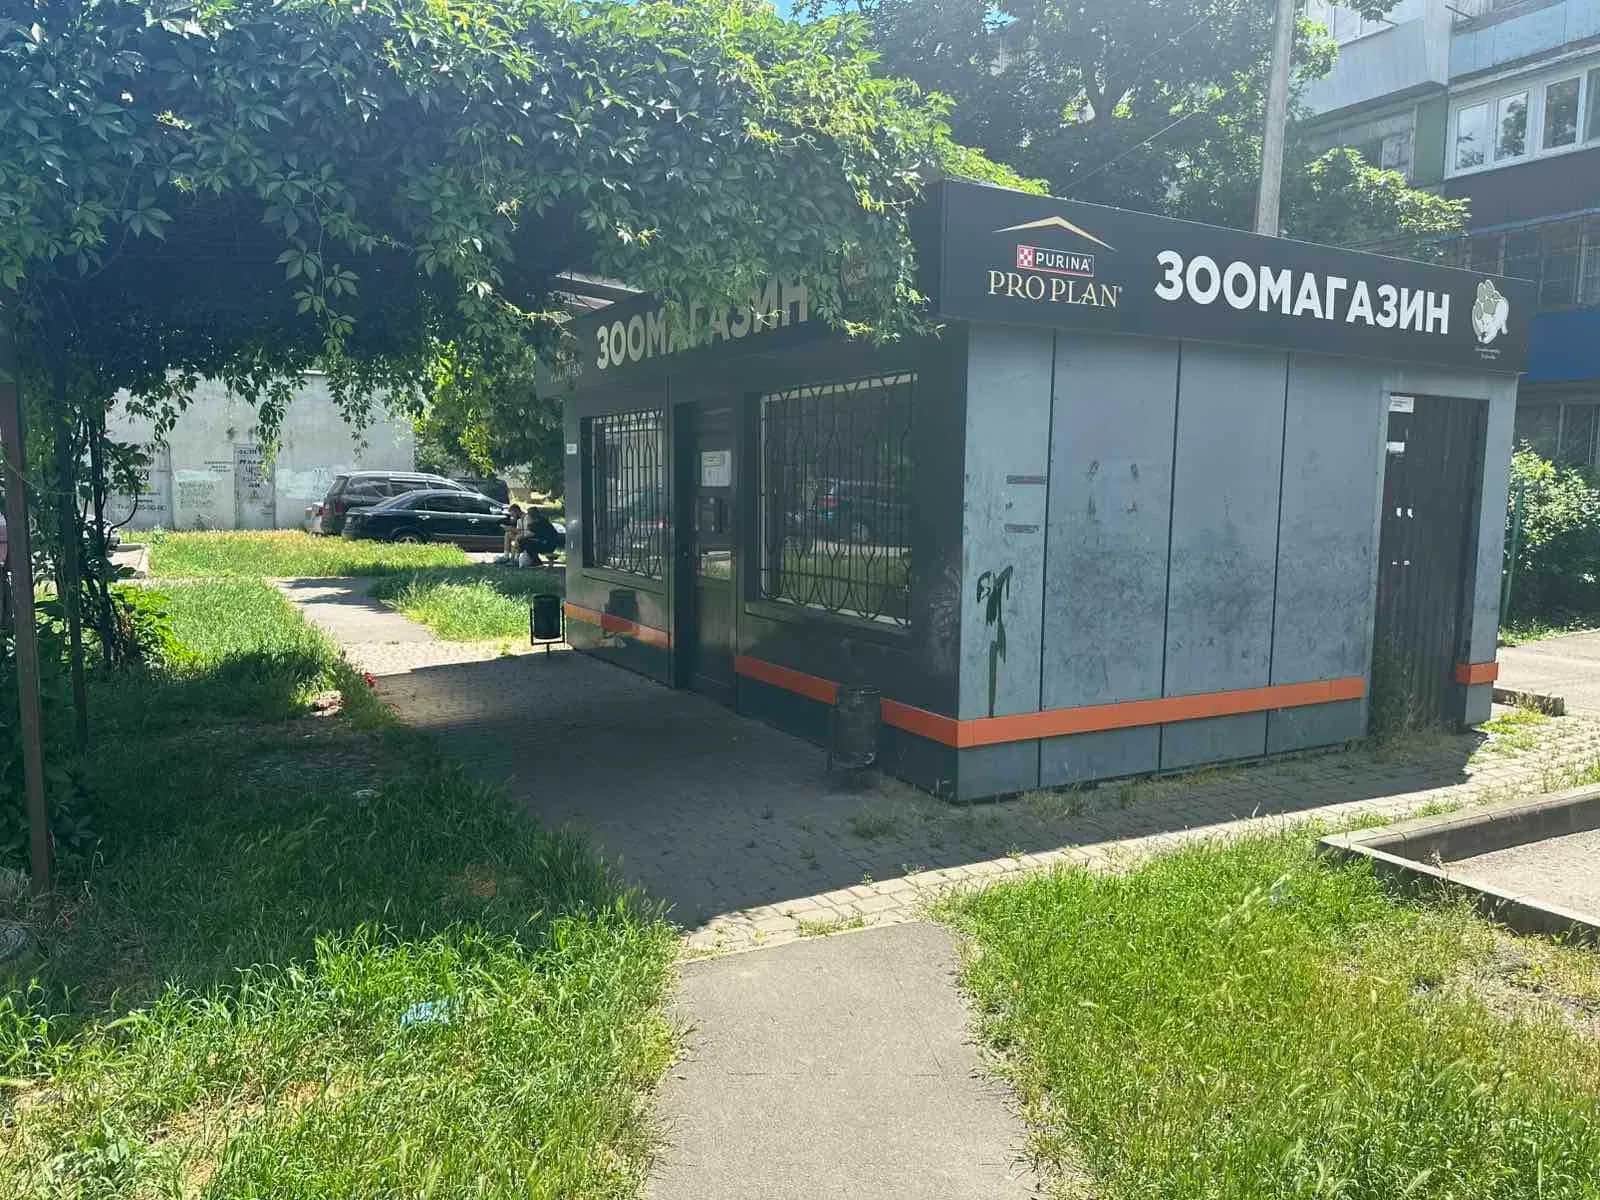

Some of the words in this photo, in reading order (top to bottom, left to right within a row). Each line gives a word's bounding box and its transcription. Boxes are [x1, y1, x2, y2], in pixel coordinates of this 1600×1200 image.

[1035, 251, 1091, 272] PURINA
[987, 269, 1047, 300] PRO
[1048, 277, 1120, 308] PLAN
[1154, 250, 1451, 335] ЗООМАГАЗИН
